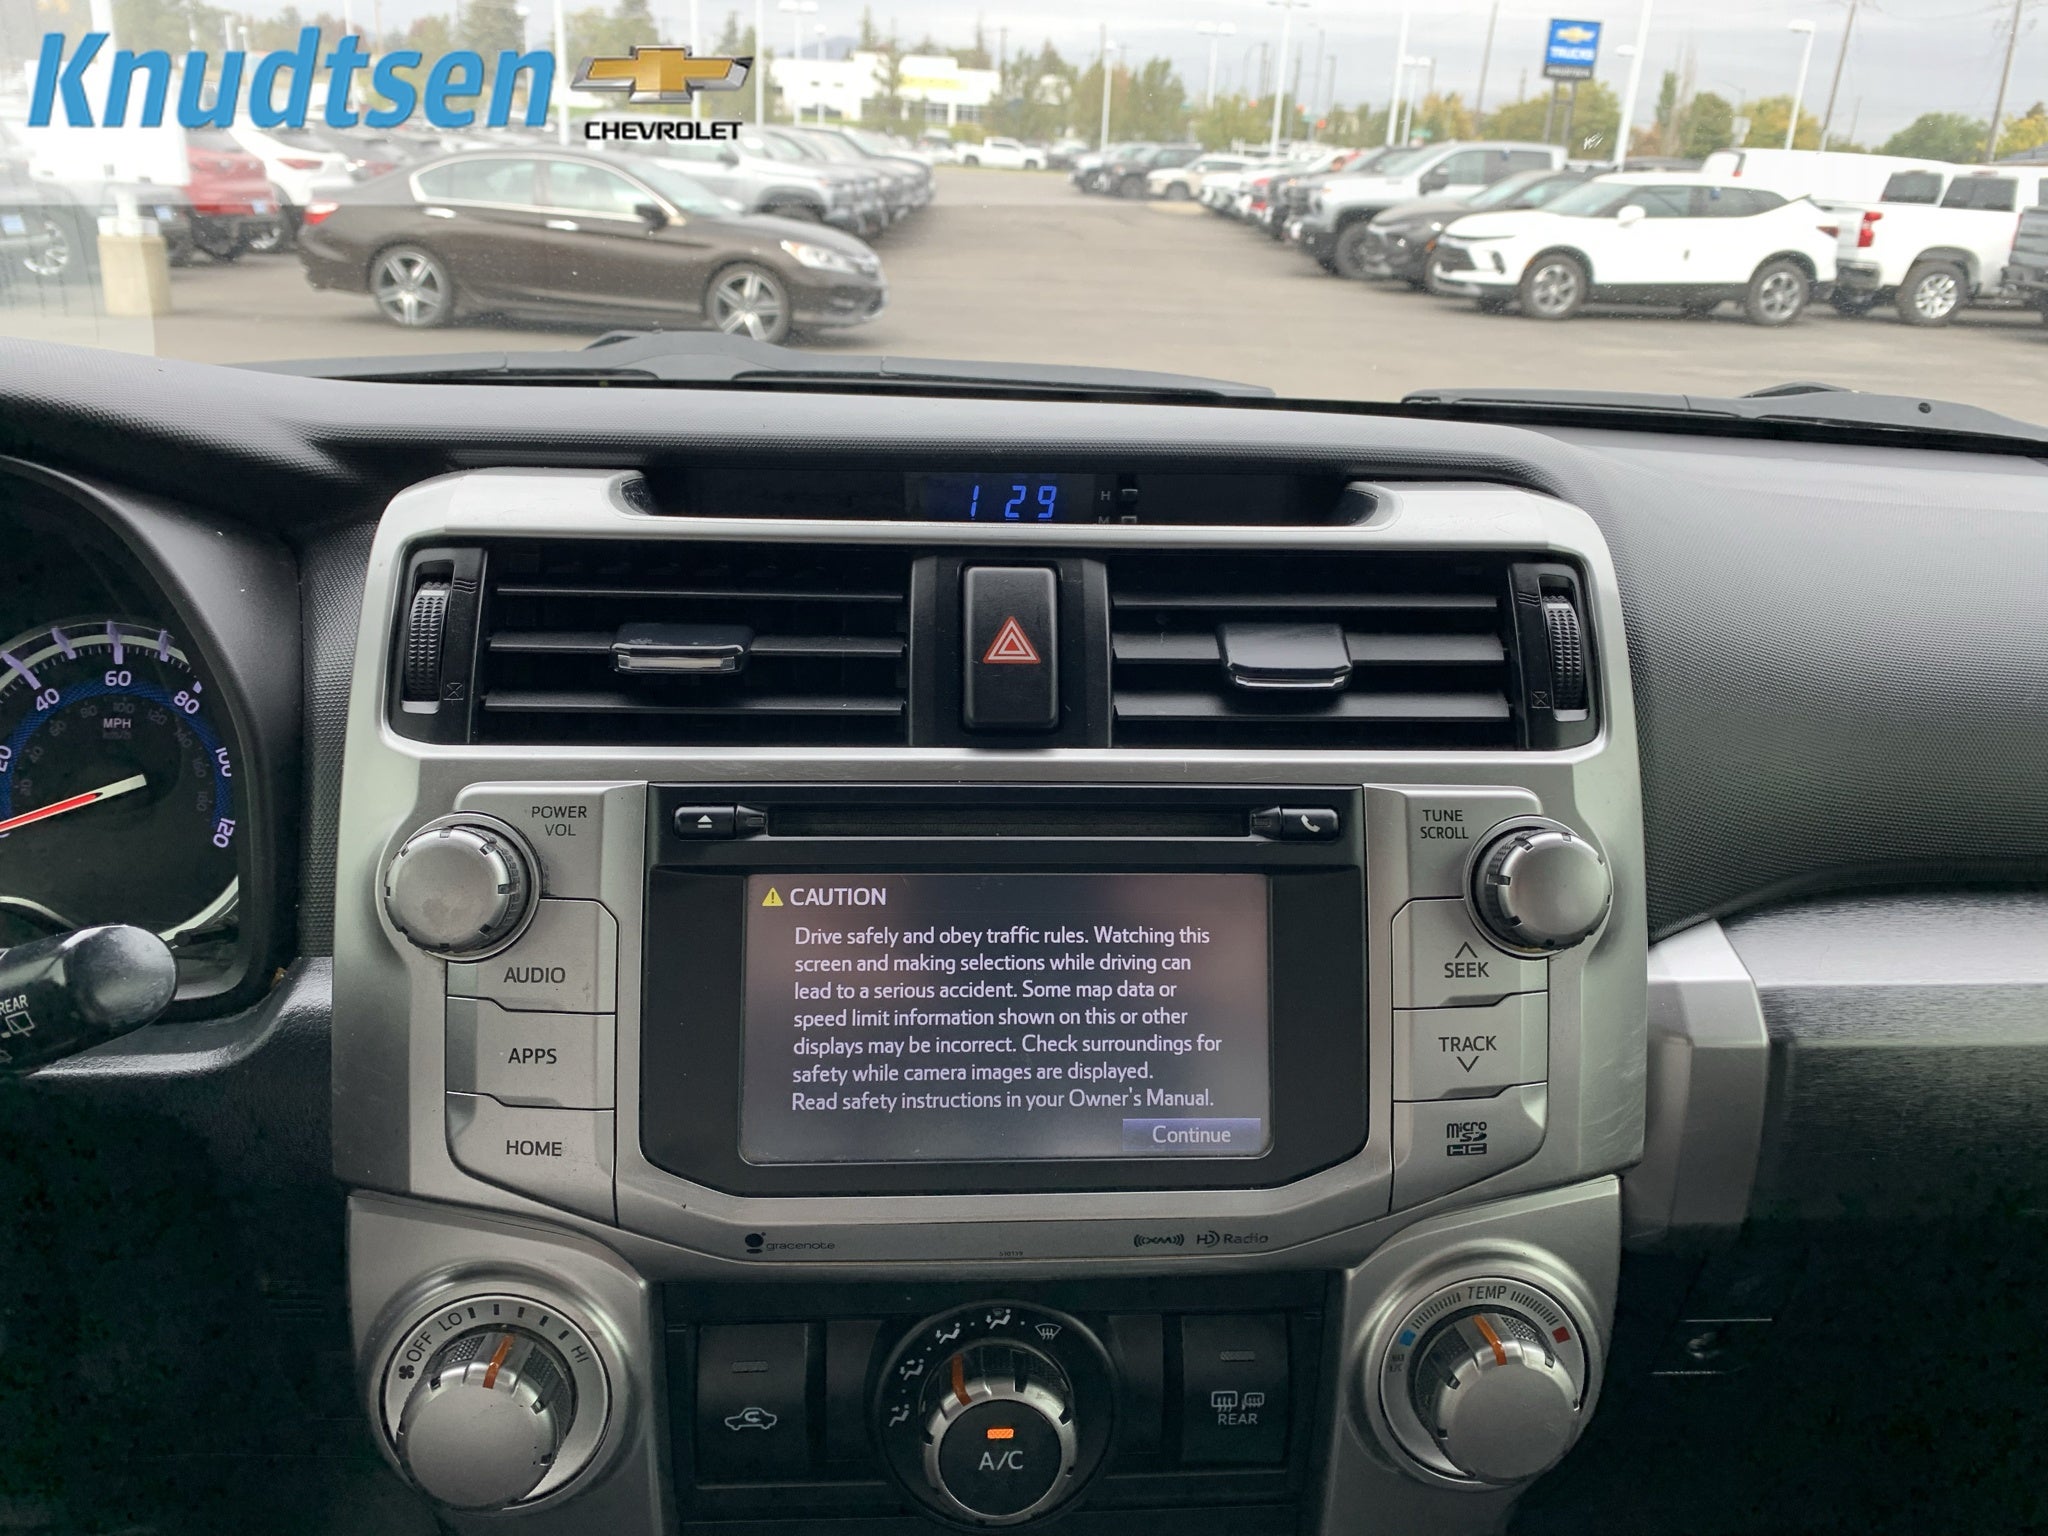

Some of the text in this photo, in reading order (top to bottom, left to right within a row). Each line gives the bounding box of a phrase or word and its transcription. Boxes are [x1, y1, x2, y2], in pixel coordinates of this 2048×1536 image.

[1100, 490, 1111, 501] H
[104, 670, 132, 687] 60
[35, 688, 60, 712] 40
[173, 690, 200, 715] 80
[103, 718, 131, 729] MPH
[531, 805, 588, 820] POWER
[1422, 808, 1464, 823] TUNE
[212, 817, 236, 848] 120
[544, 823, 577, 838] VOL
[1419, 826, 1470, 840] SCROLL
[789, 888, 888, 907] CAUTION
[795, 925, 1210, 949] Drive safely and obey traffic rules. Watching this
[794, 952, 1192, 975] screen and making selections while driving can
[1443, 961, 1490, 979] SEEK
[503, 966, 567, 984] AUDIO
[794, 979, 1178, 1002] lead to a serious accident. Some map data or
[0, 994, 29, 1015] REAR
[793, 1006, 1189, 1032] speed limit information shown on this or other
[793, 1033, 1223, 1059] displays may be incorrect. Check surroundings for
[1438, 1035, 1498, 1052] TRACK
[507, 1048, 558, 1065] APPS
[792, 1060, 1154, 1087] safety while camera images are displayed.
[791, 1086, 1214, 1114] Read safety instructions in your Owner's Manual.
[1152, 1125, 1232, 1144] Continue
[505, 1140, 563, 1157] HOME
[766, 1241, 836, 1252] gracenote
[1223, 1232, 1269, 1245] Radio
[1468, 1285, 1507, 1300] TEMP
[438, 1312, 463, 1333] LO
[406, 1330, 434, 1362] OFF
[571, 1345, 590, 1364] HI
[1217, 1412, 1258, 1426] REAR
[978, 1450, 1024, 1472] A/C
